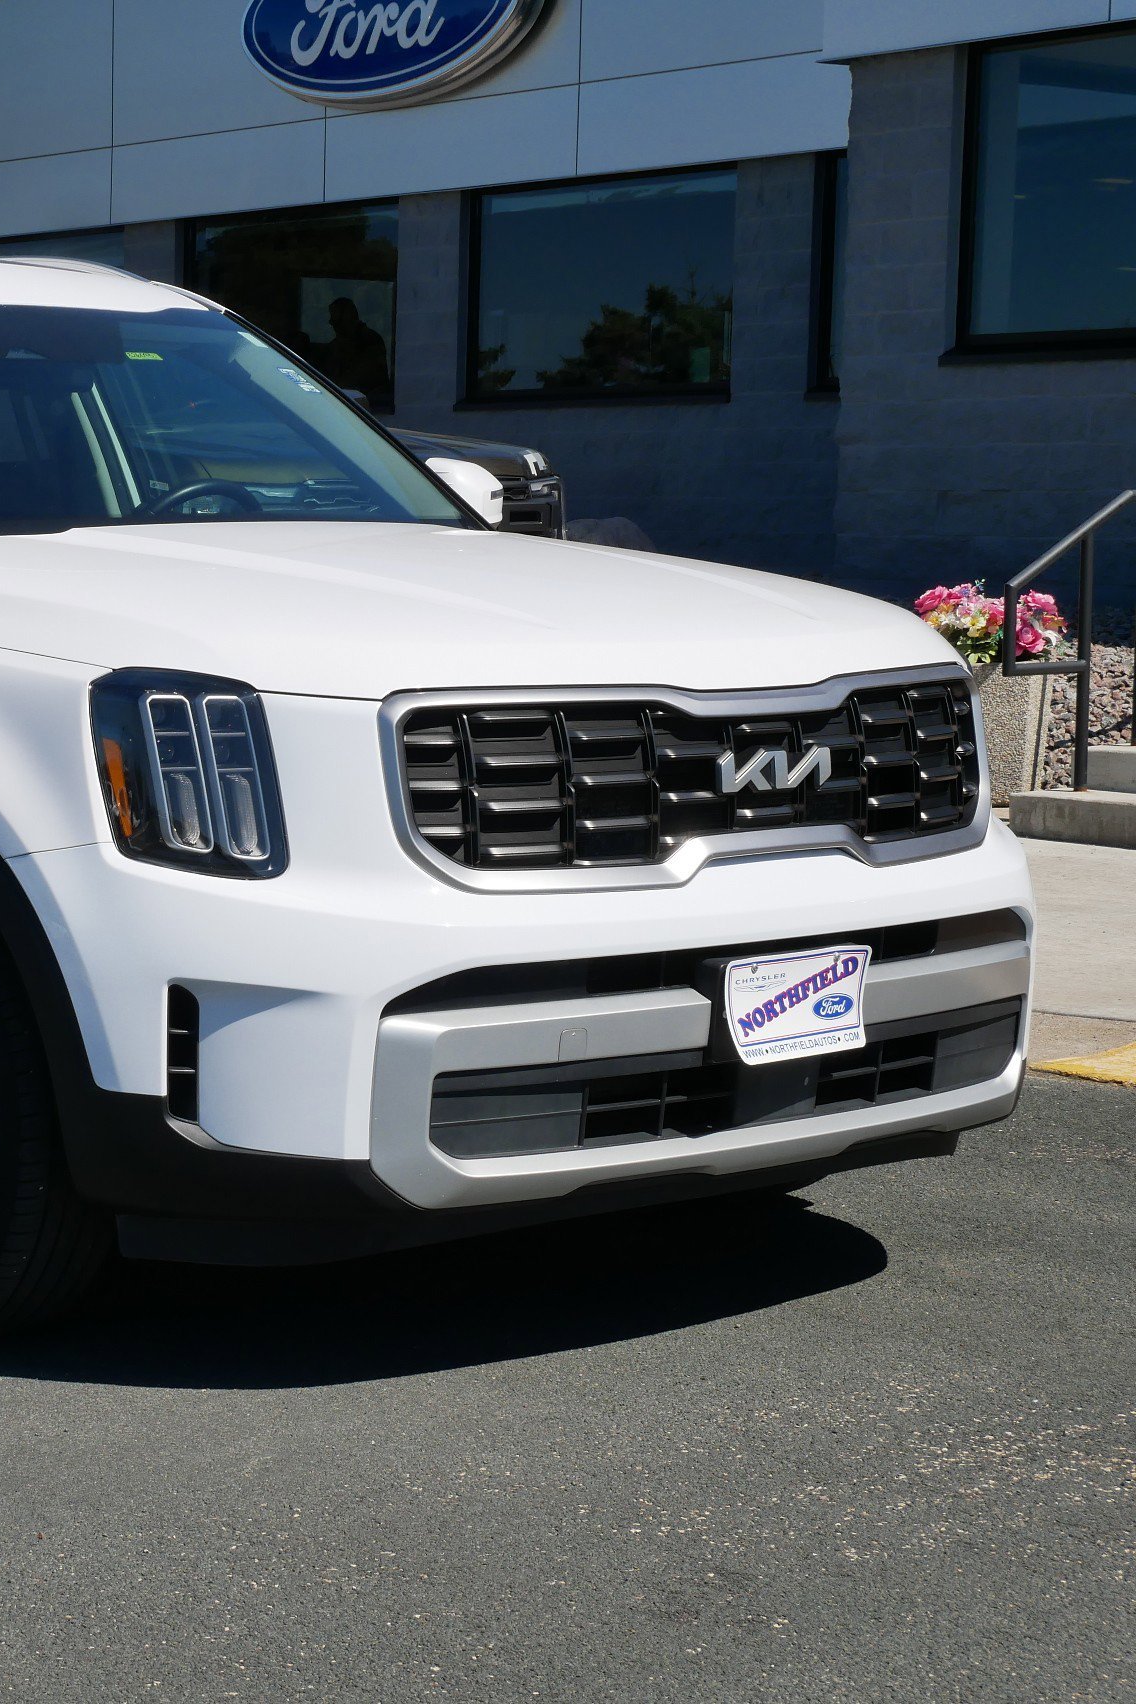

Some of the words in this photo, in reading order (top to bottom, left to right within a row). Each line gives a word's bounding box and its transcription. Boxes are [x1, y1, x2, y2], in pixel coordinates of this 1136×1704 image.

[290, 0, 444, 66] Ford
[719, 745, 832, 793] KIA
[735, 972, 786, 985] CHRYSLER
[737, 956, 859, 1038] NORTHFIELD
[819, 997, 846, 1016] Ford
